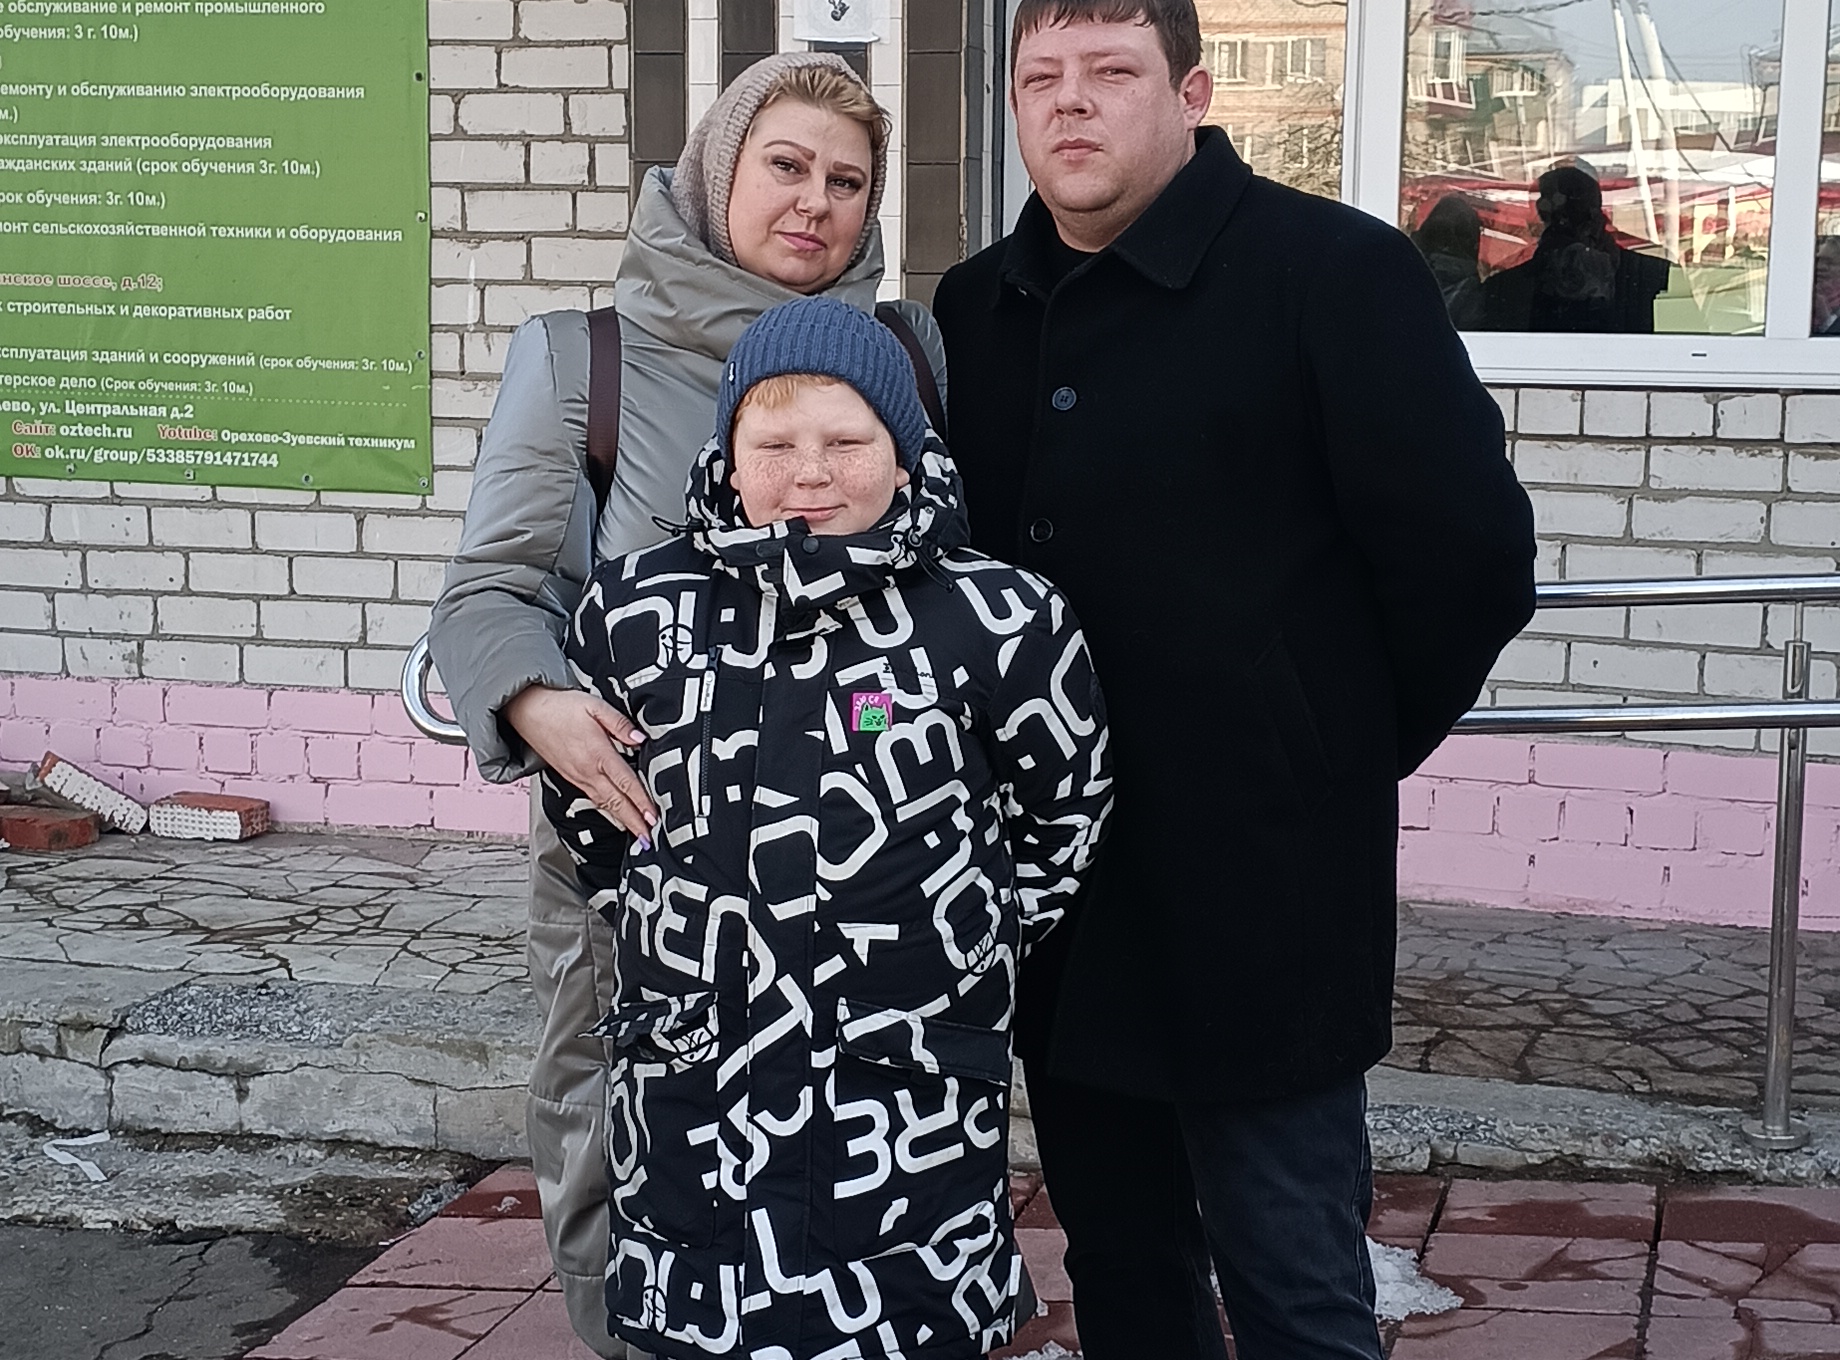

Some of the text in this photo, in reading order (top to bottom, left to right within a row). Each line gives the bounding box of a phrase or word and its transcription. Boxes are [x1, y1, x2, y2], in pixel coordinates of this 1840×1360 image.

[8, 0, 117, 16] обслуживание
[122, 2, 131, 13] и
[136, 2, 191, 16] ремонт
[195, 2, 325, 16] промышленного
[75, 25, 83, 39] 3
[88, 28, 96, 39] г.
[101, 25, 138, 42] 10м.)
[58, 85, 66, 96] и
[71, 82, 186, 99] обслуживанию
[190, 83, 364, 101] электрооборудования
[101, 133, 271, 151] электрооборудования
[80, 158, 132, 173] зданий
[137, 158, 178, 175] (срок
[182, 158, 255, 176] обучения
[259, 160, 277, 174] 3г.
[282, 160, 320, 178] 10м.)
[27, 190, 101, 207] обучения:
[106, 192, 123, 205] 3г.
[127, 192, 165, 209] 10м.)
[0, 222, 402, 243] онт сельскохозяйственной техники и оборудования
[0, 274, 163, 292] нское шоссе, д.12;
[7, 302, 116, 316] строительных
[120, 305, 129, 315] и
[133, 305, 243, 320] декоративных
[248, 306, 292, 322] работ
[0, 348, 412, 374] сплуатация зданий и сооружений (срок обучения: 3г. 10м.)
[60, 377, 96, 389] дело
[101, 377, 135, 391] (Срок
[138, 379, 201, 393] обучения:
[205, 381, 218, 392] 3г.
[222, 381, 253, 396] 10м.)
[0, 400, 193, 420] ево, ул. Центральная д.2
[12, 420, 56, 436] Сайт:
[60, 423, 132, 438] oztech.ru
[221, 430, 345, 446] Орехово-Зуевский
[348, 437, 415, 451] техникум
[45, 445, 278, 469] ok.ru/group/53385791471744
